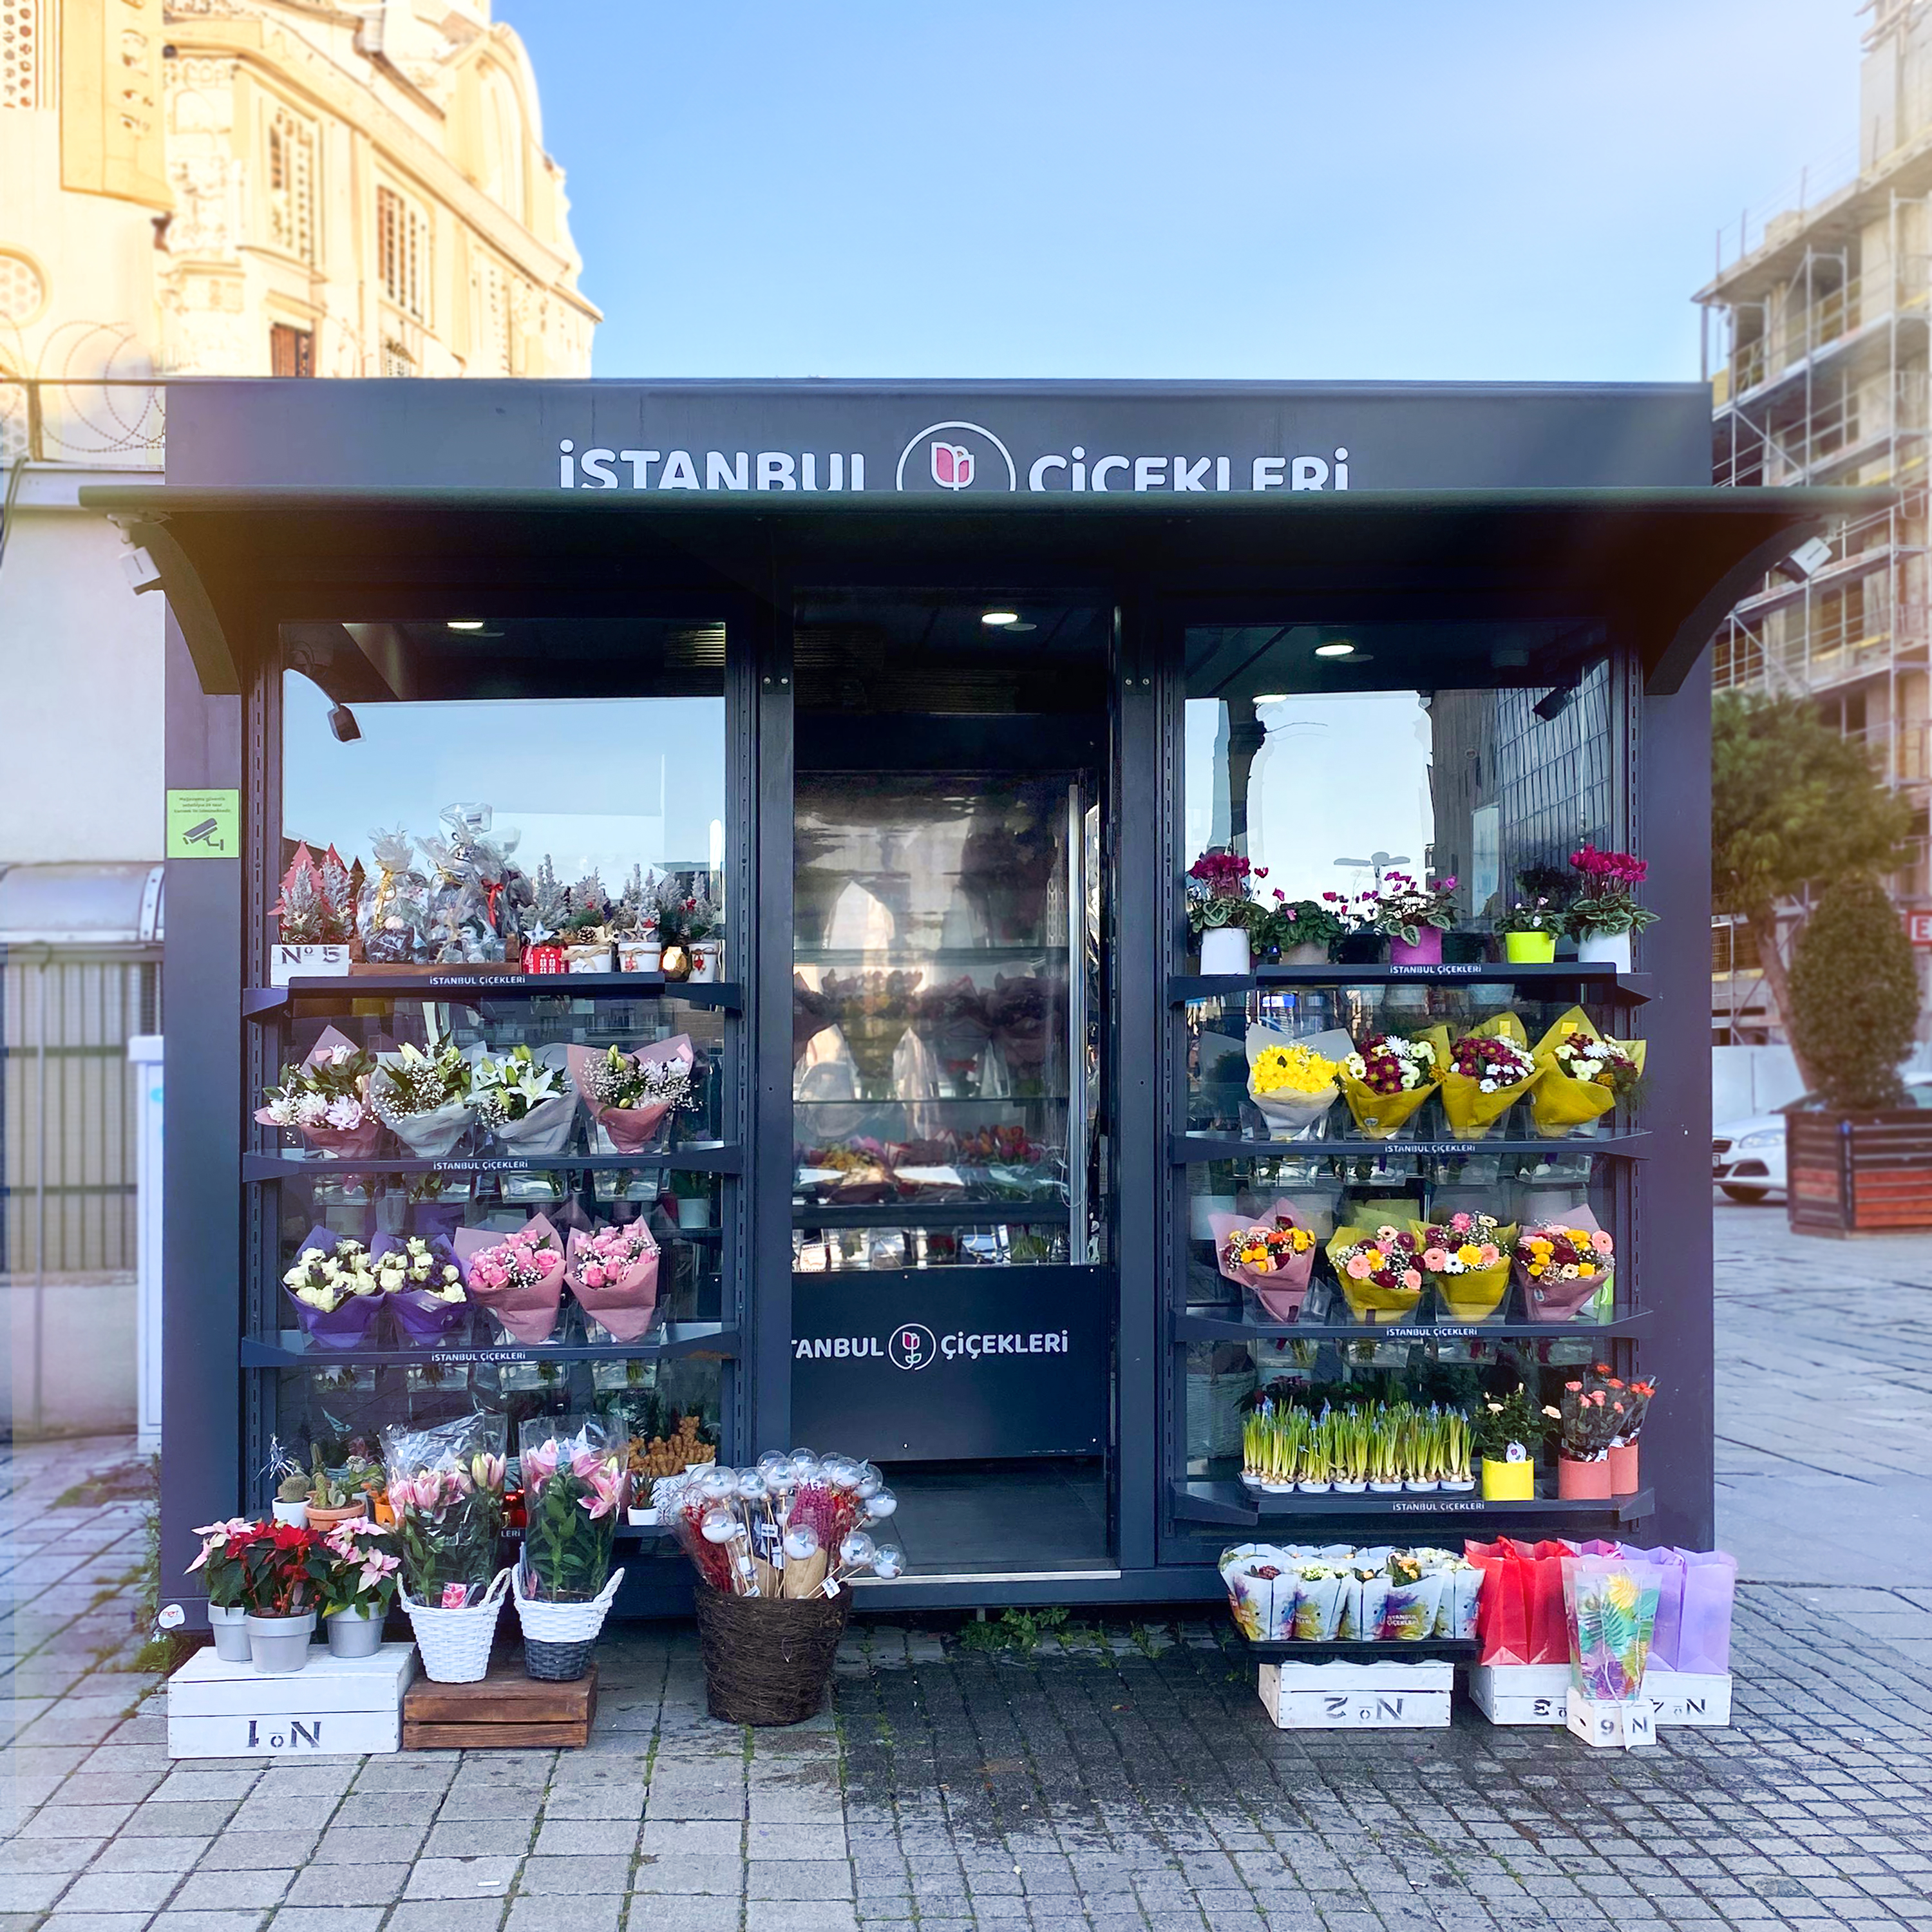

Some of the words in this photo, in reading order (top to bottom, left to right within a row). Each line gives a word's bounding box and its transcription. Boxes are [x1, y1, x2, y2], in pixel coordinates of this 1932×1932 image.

[323, 947, 339, 963] 5
[1390, 965, 1435, 974] İSTANBUL
[1437, 964, 1481, 974] ÇİÇEKLERİ
[430, 974, 477, 985] İSTANBUL
[479, 974, 526, 985] ÇİÇEKLERİ
[433, 1160, 480, 1170] İSTANBUL
[482, 1159, 528, 1170] ÇİÇEKLERİ
[1387, 1327, 1430, 1336] İSTANBUL
[1433, 1327, 1477, 1337] ÇİÇEKLERİ
[791, 1337, 884, 1359] ANBUL
[940, 1330, 1069, 1359] ÇİÇEKLERİ
[431, 1352, 478, 1361] İSTANBUL
[480, 1351, 526, 1361] ÇİÇEKLERİ
[1324, 1696, 1348, 1719] 2
[246, 1720, 260, 1747] 1
